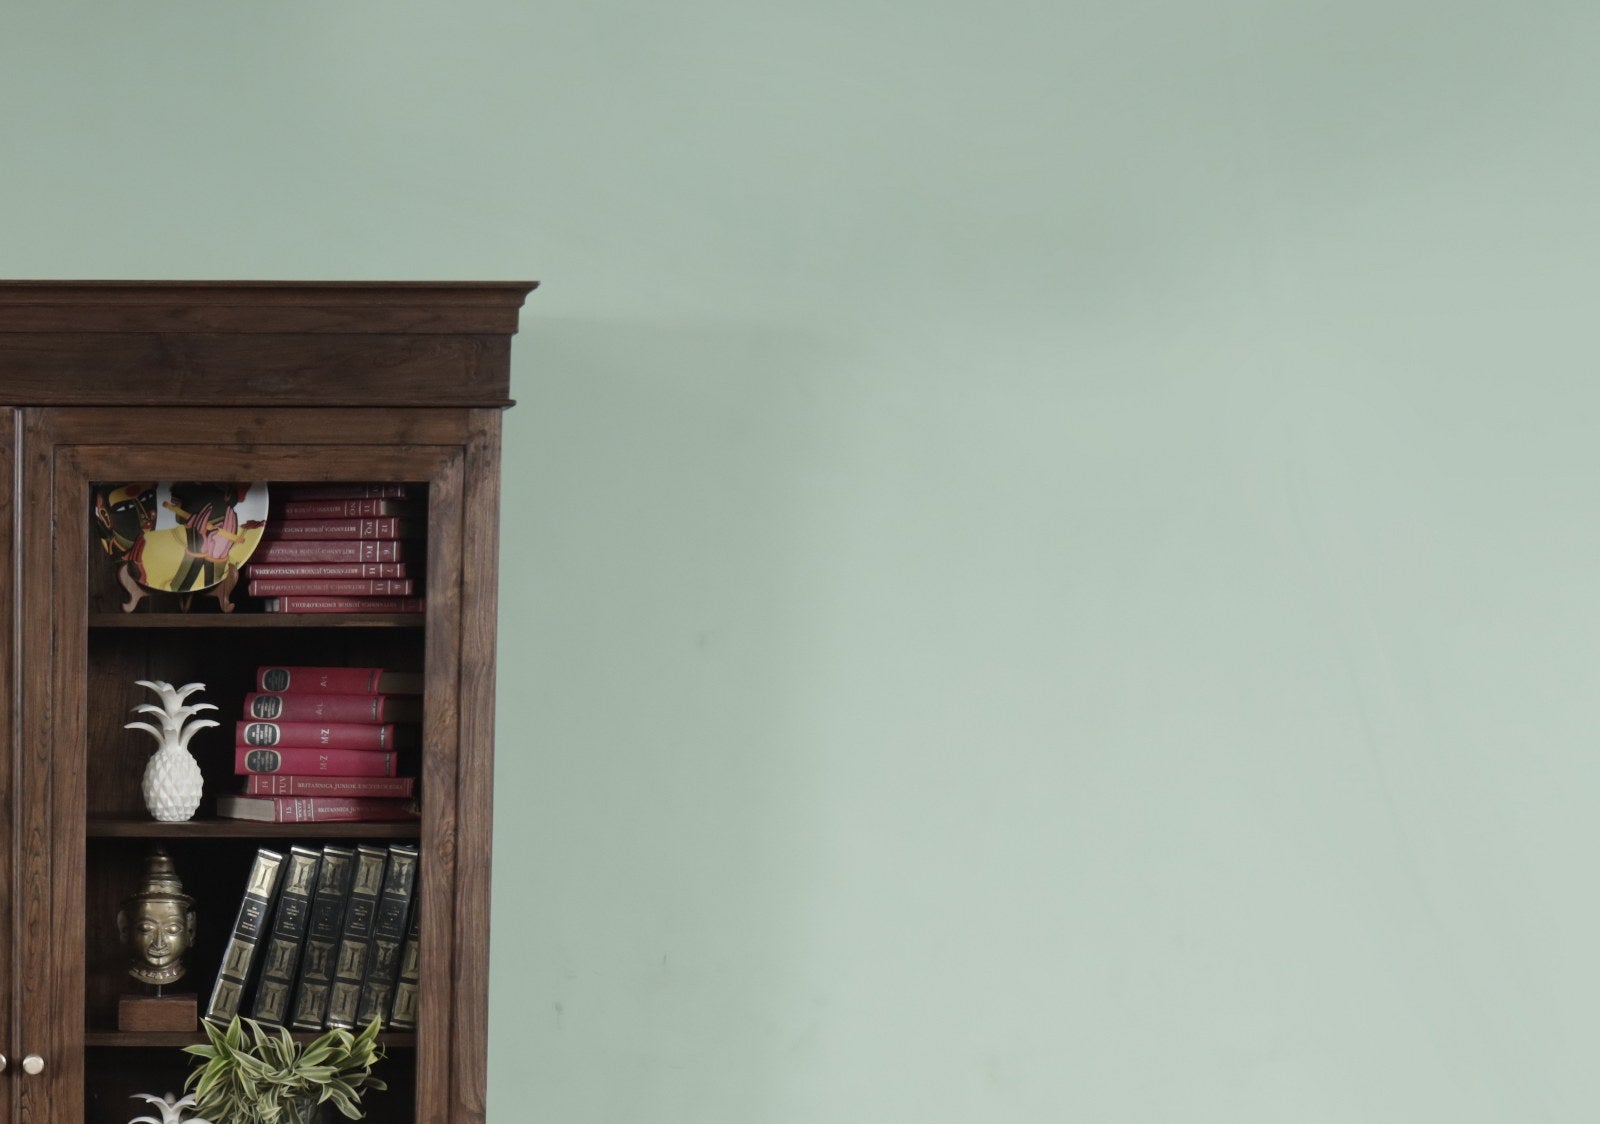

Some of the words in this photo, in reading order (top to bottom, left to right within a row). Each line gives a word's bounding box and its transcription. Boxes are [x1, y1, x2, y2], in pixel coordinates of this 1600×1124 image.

[304, 525, 324, 533] JUNIOR
[363, 522, 373, 536] PQ
[299, 548, 321, 556] JUNIOR
